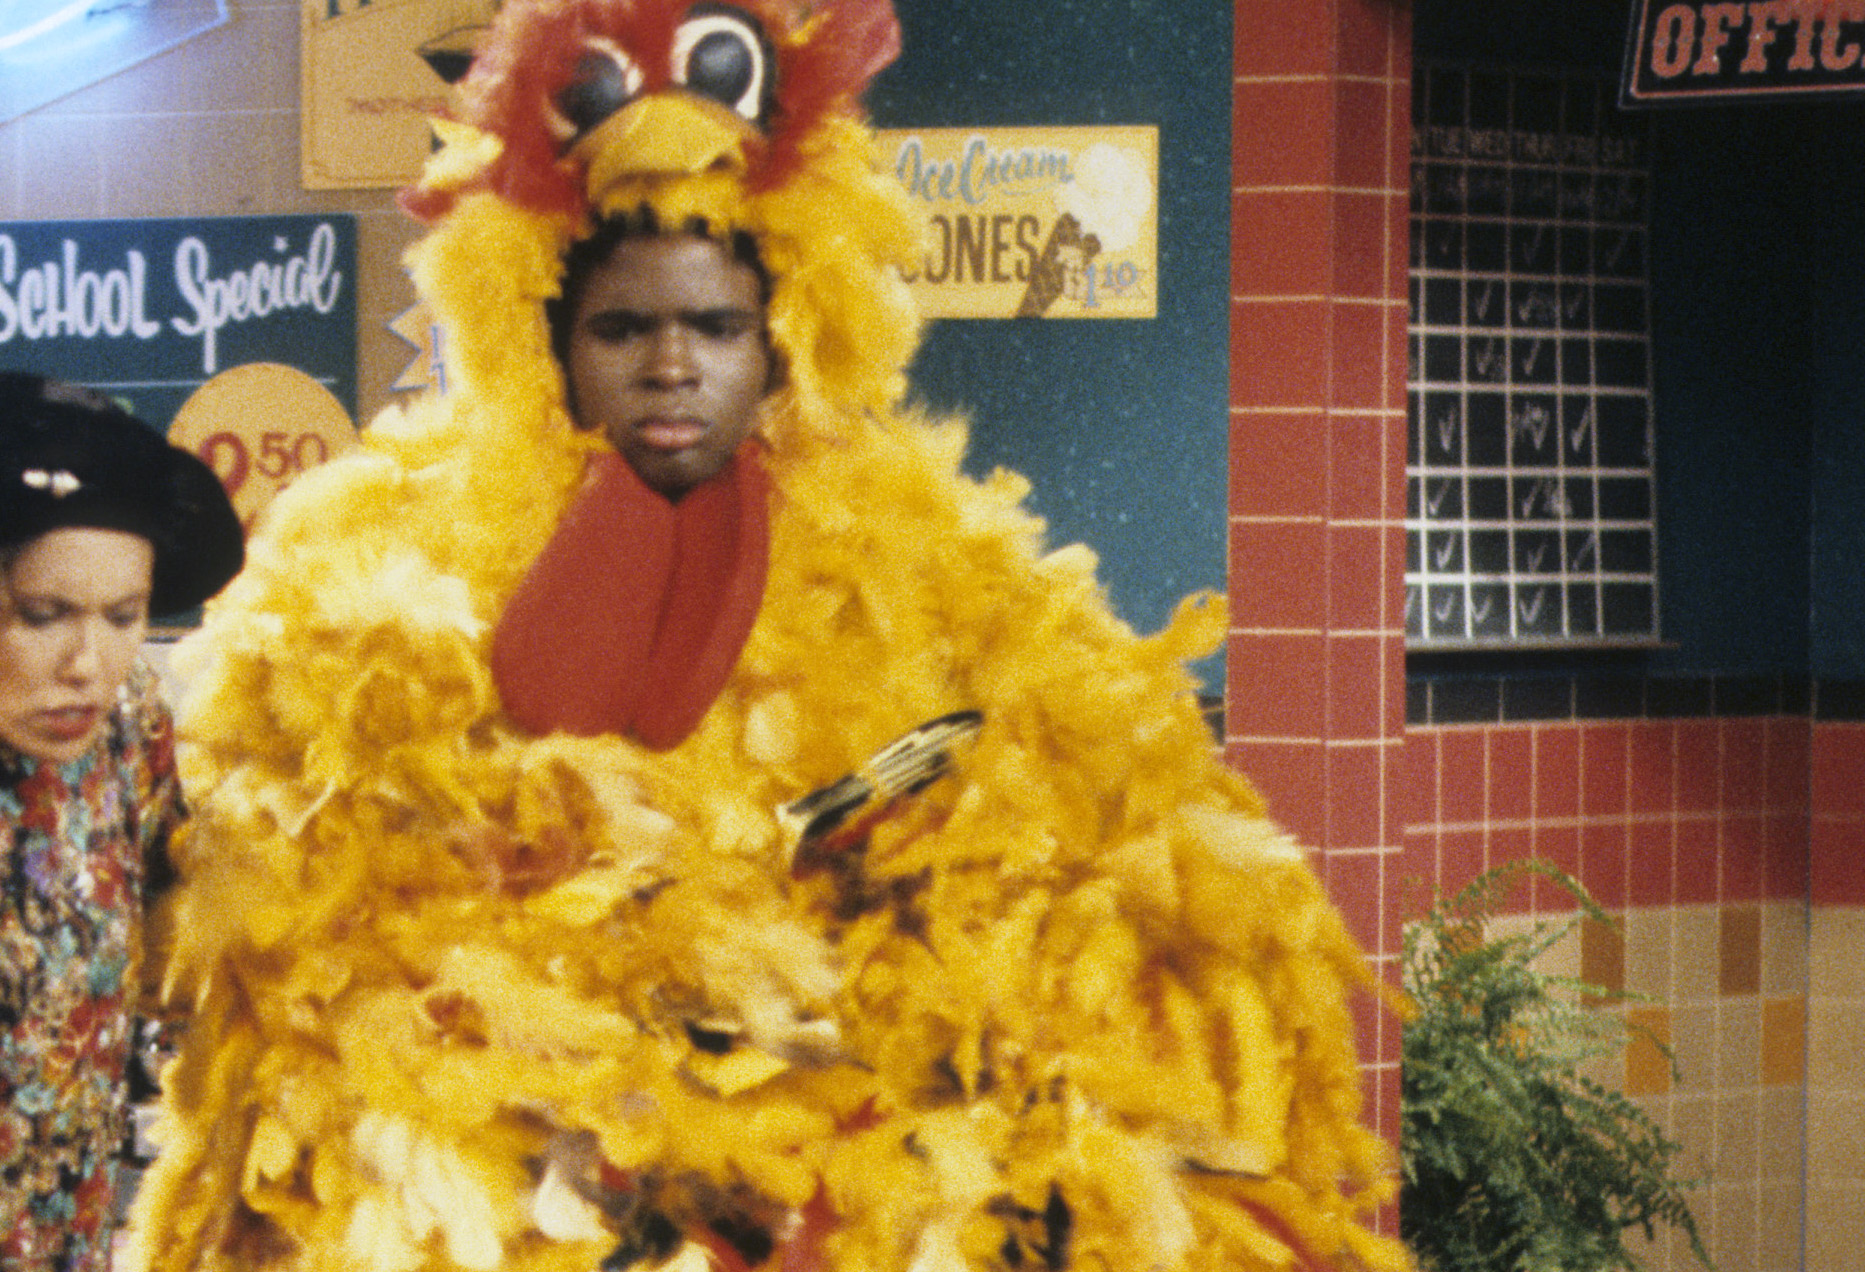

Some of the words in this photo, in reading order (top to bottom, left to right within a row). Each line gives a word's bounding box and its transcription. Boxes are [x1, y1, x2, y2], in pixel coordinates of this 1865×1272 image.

[1651, 1, 1865, 78] OFFIC
[959, 138, 1076, 204] Cream
[171, 223, 340, 374] Special
